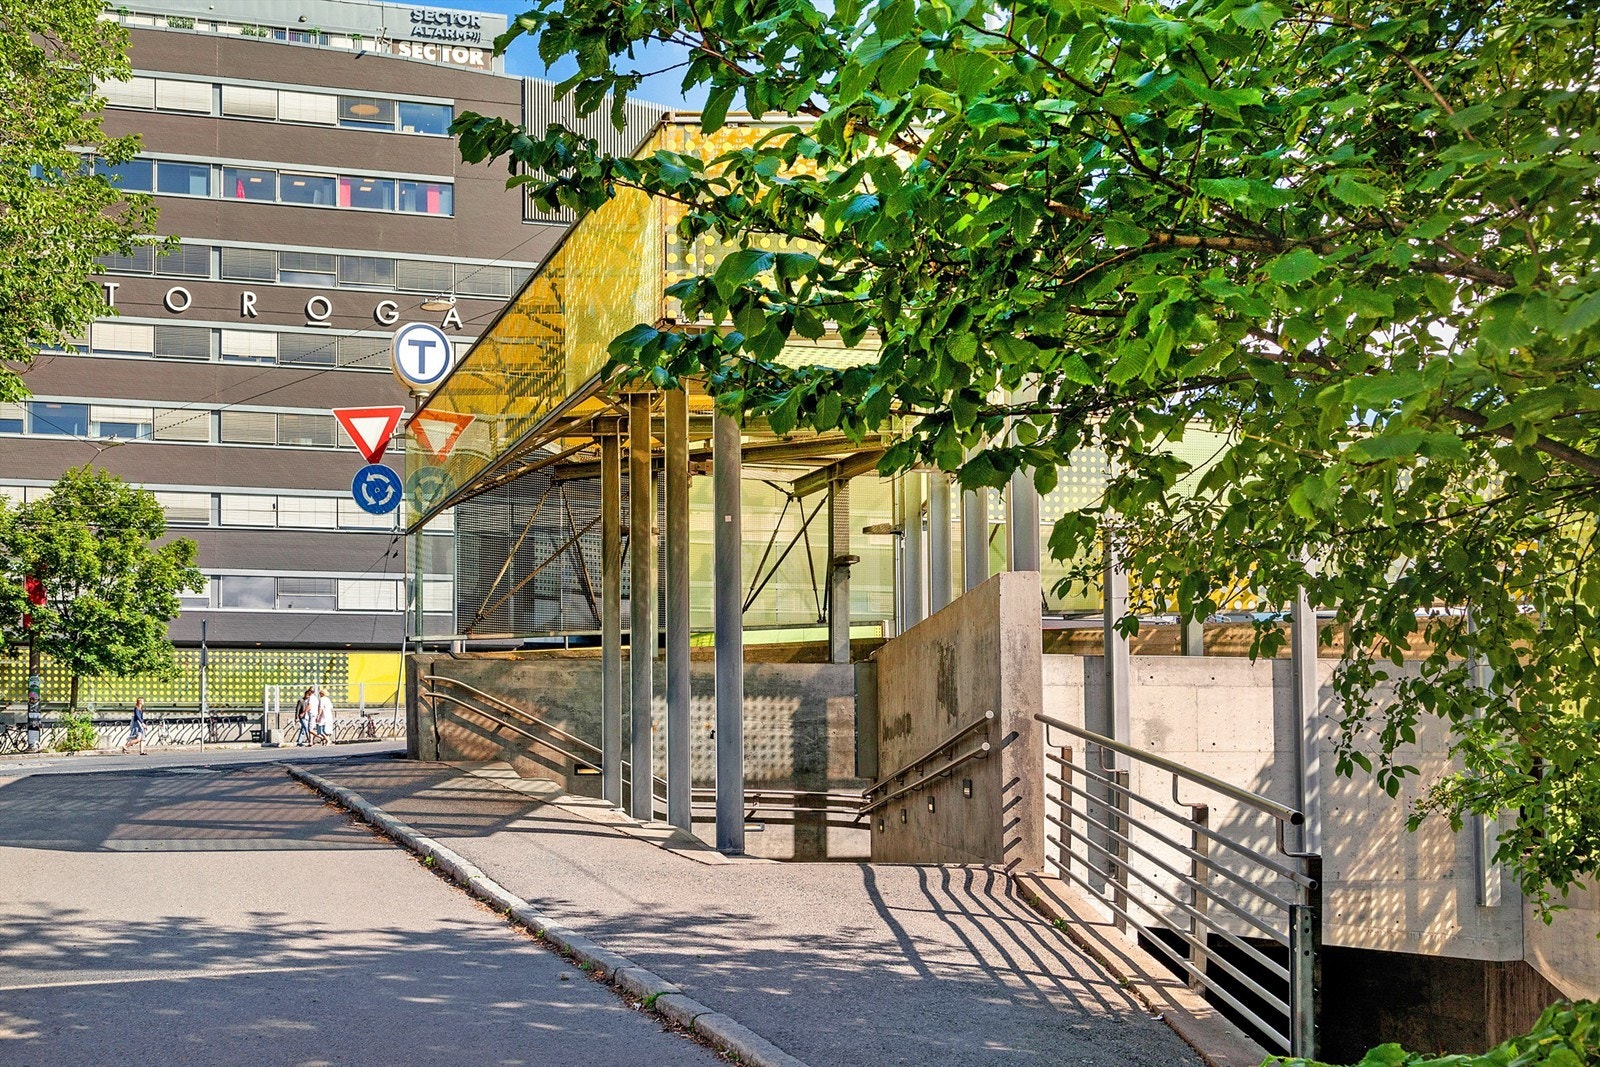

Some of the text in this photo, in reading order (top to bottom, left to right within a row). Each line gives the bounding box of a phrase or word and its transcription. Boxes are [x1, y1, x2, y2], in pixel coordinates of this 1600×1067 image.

[410, 8, 481, 29] SECTOR
[398, 41, 485, 65] SECTOR
[407, 339, 437, 375] T
